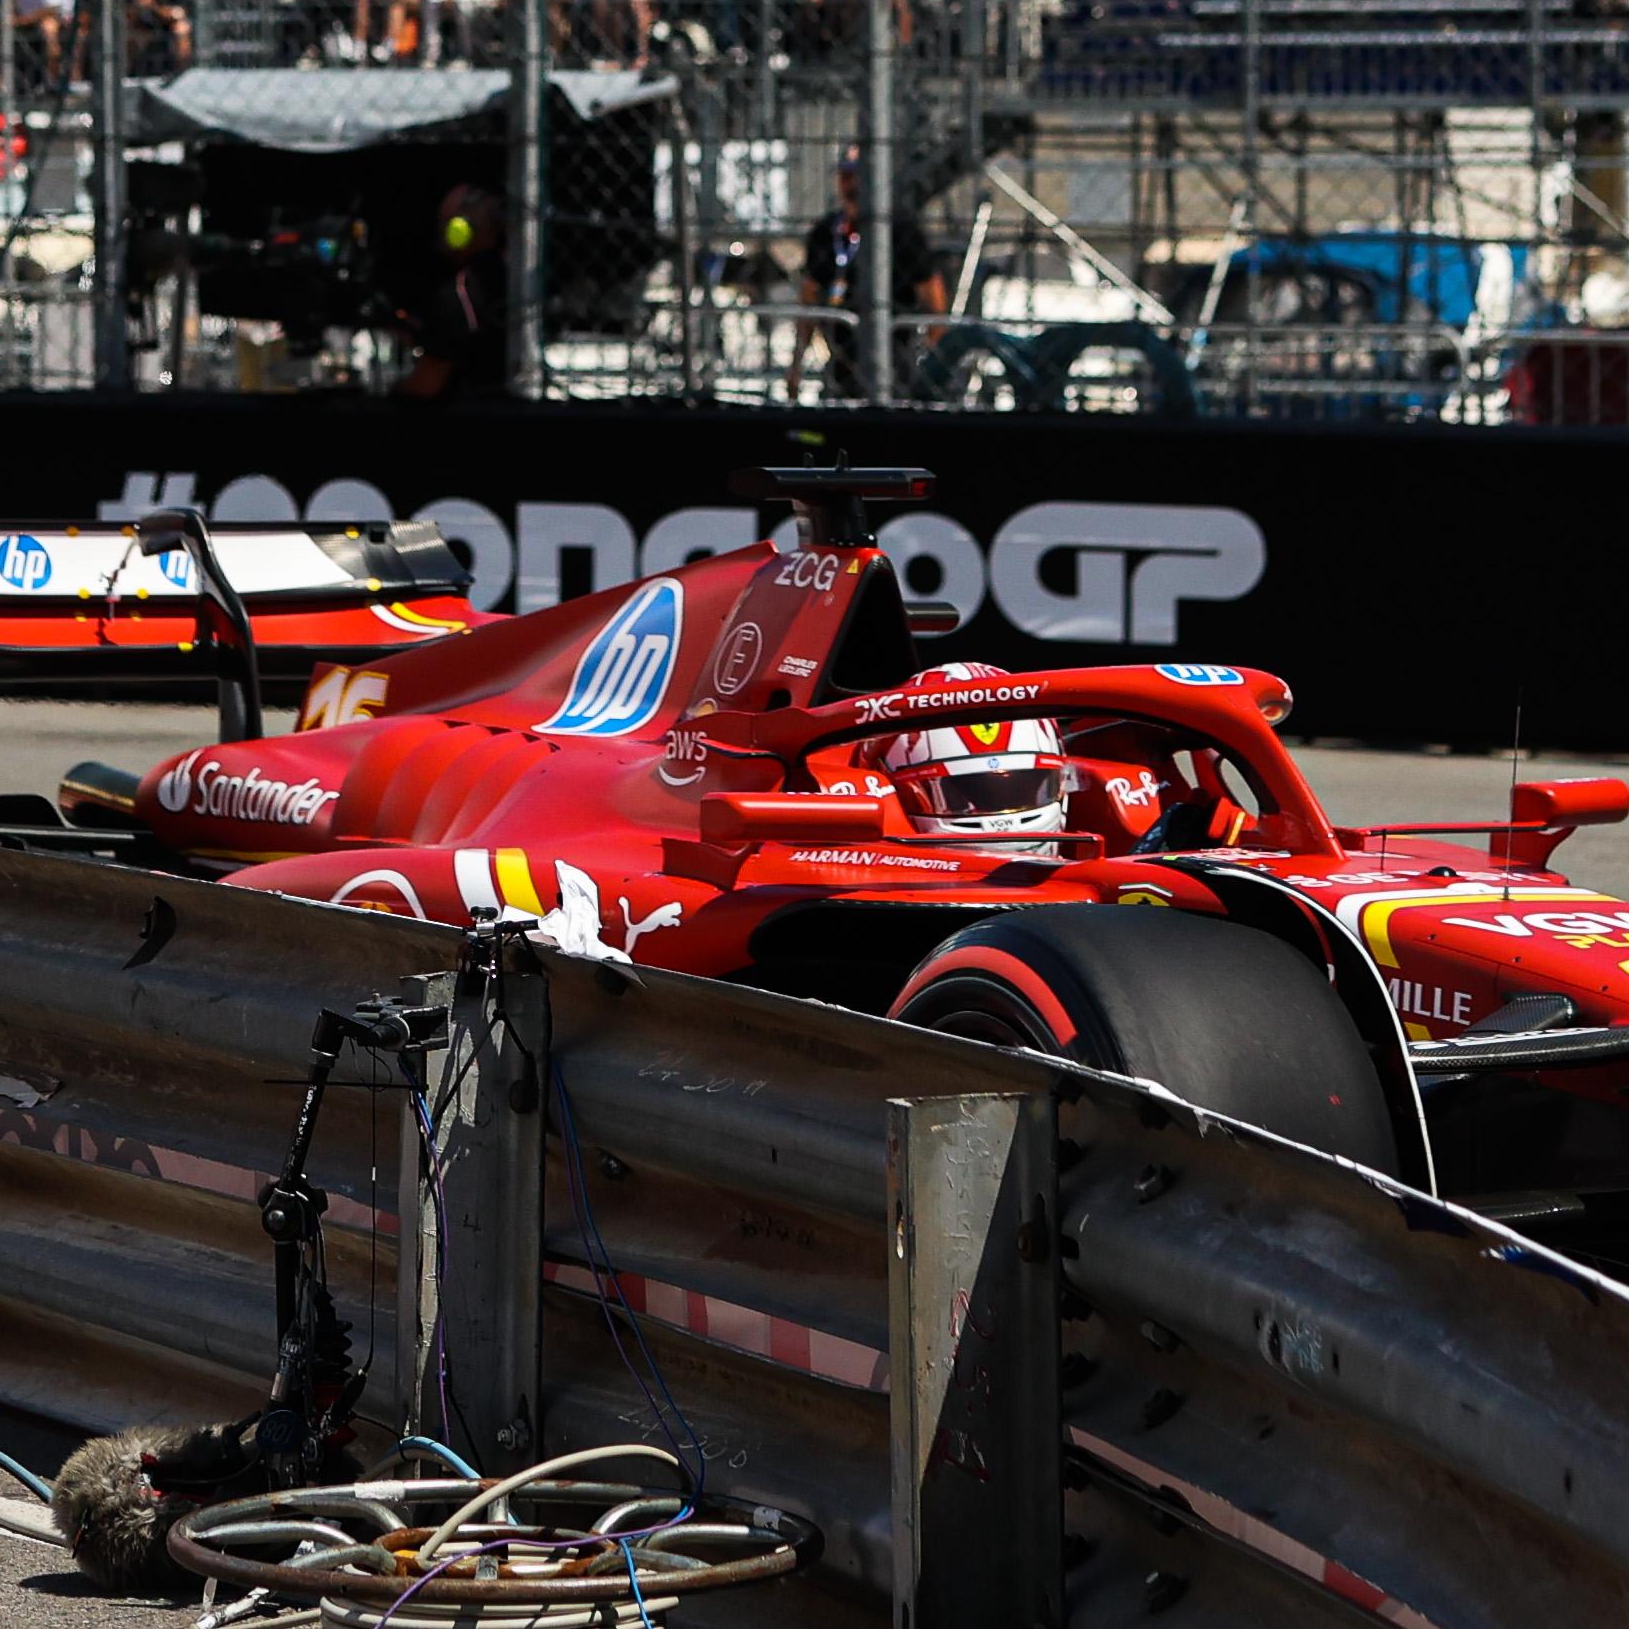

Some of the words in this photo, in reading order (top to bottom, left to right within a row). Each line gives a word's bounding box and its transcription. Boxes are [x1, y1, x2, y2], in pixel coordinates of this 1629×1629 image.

[0, 534, 49, 590] hp
[774, 551, 839, 591] ZCG
[540, 582, 672, 732] hp
[1164, 663, 1234, 685] hp
[907, 684, 1040, 709] TECHNOLOGY
[665, 729, 708, 763] aws
[193, 760, 341, 825] Santander
[789, 850, 874, 866] HARMAN
[879, 855, 961, 872] AUTOMOTIVE
